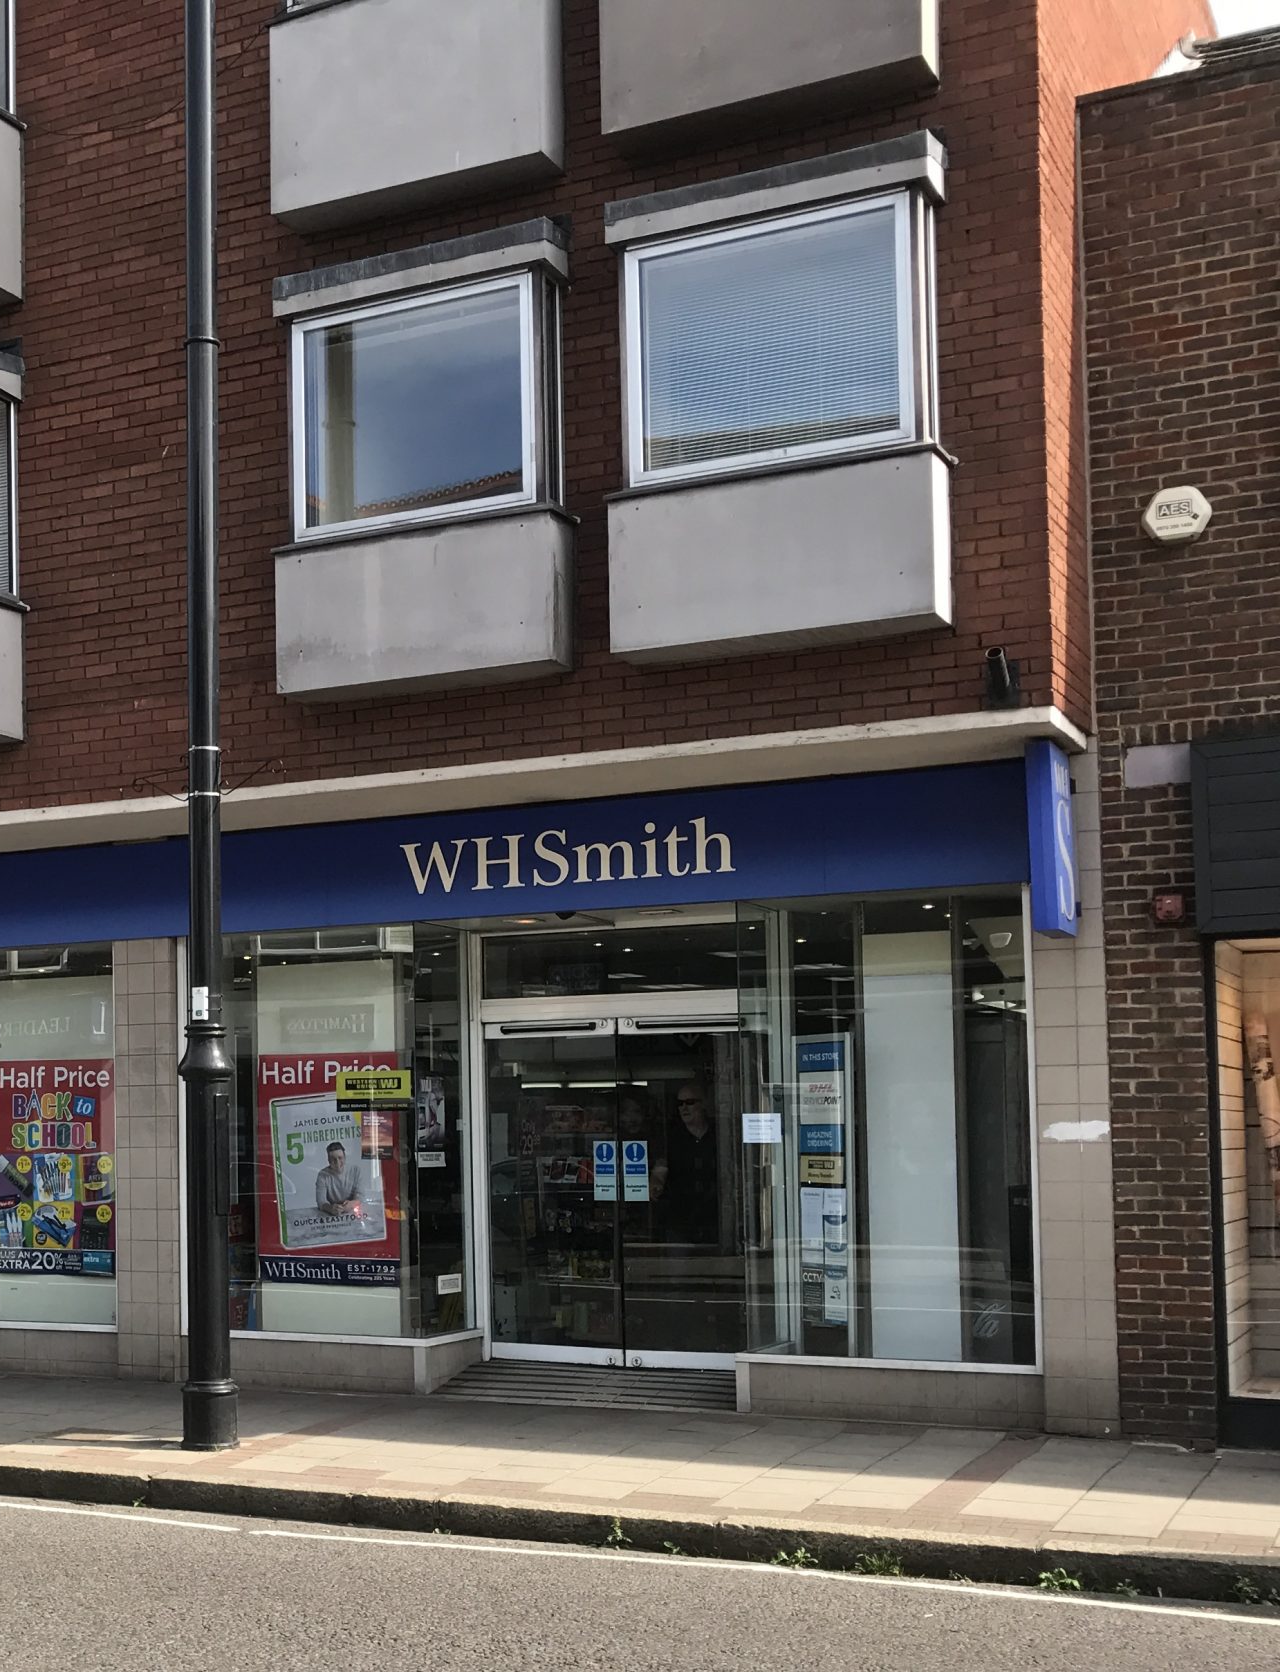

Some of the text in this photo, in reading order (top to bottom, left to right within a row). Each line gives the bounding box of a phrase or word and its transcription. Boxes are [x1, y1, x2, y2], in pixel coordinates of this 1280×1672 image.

[1160, 502, 1189, 516] AES
[399, 816, 736, 895] WHSmith
[809, 1053, 821, 1061] THIS
[0, 1065, 111, 1089] Half Price
[262, 1060, 315, 1085] Half
[381, 1078, 398, 1089] WU
[809, 1084, 834, 1093] DHL
[11, 1089, 92, 1121] BACK to
[293, 1117, 318, 1128] JAMIE
[320, 1114, 352, 1125] OLIVER
[11, 1120, 97, 1150] SCHOOL
[303, 1125, 362, 1144] INGREDIENTS
[286, 1131, 305, 1165] 5
[293, 1219, 319, 1227] QUICK
[326, 1215, 345, 1224] EASY
[345, 1213, 368, 1221] FOOD
[18, 1251, 30, 1259] AN
[264, 1261, 341, 1280] WHSmith
